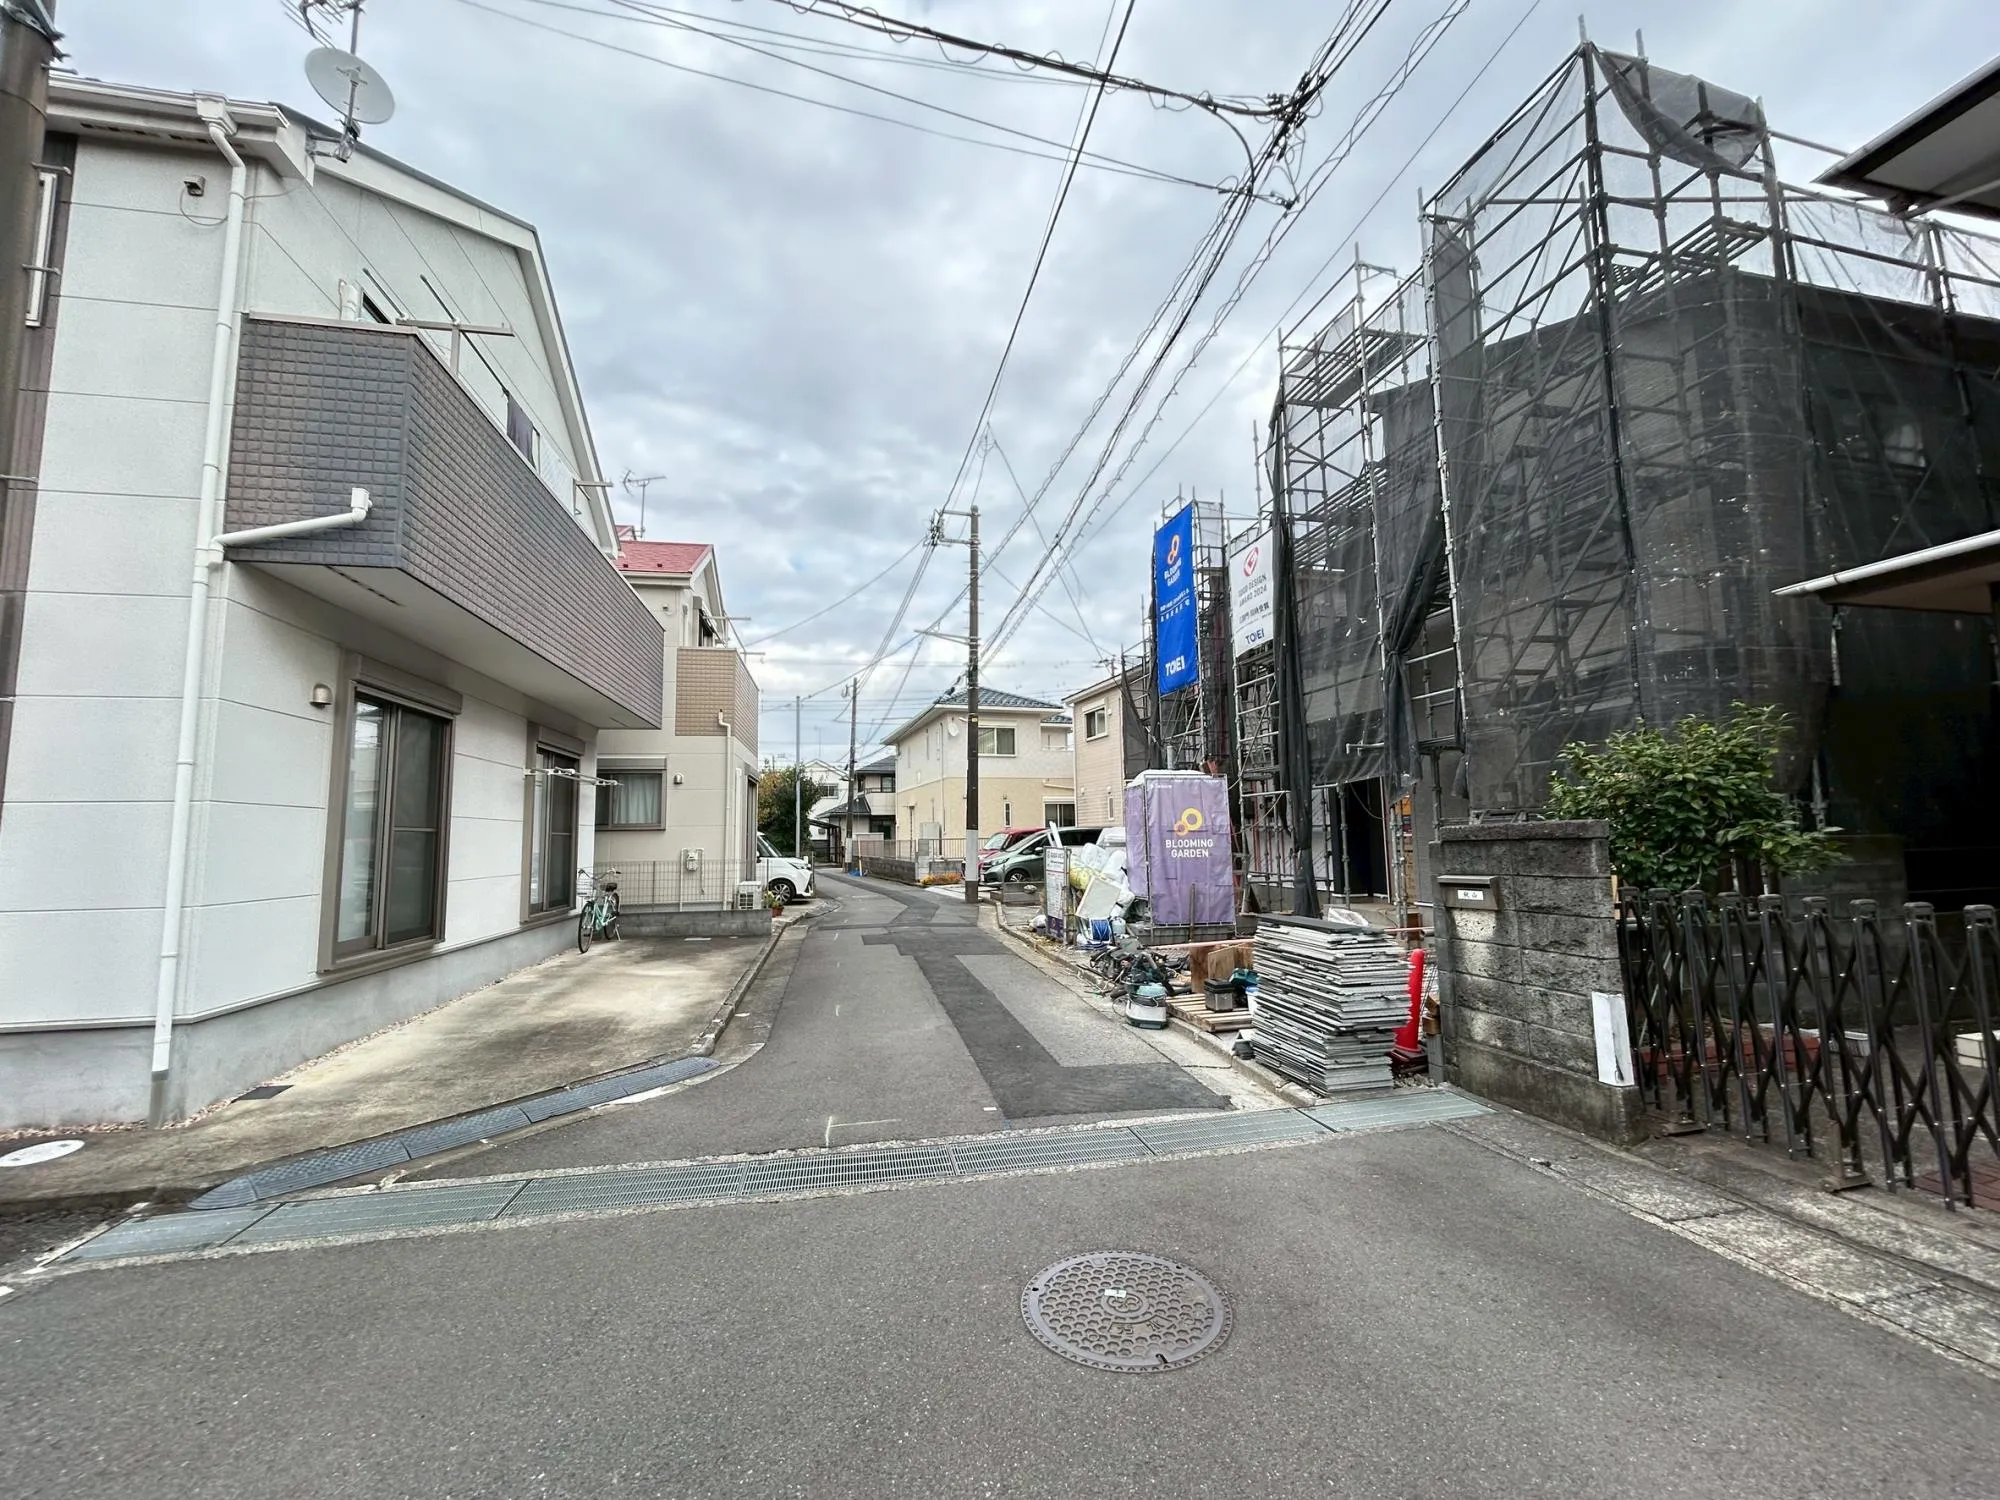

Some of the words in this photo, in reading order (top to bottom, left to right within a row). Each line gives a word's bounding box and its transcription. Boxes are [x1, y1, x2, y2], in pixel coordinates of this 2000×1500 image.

[1248, 574, 1267, 590] DESIGN
[1253, 584, 1267, 598] 2024
[1245, 628, 1265, 645] TOEI
[1165, 655, 1185, 677] TOEI
[1165, 838, 1214, 849] BLOOMING
[1171, 848, 1209, 858] GARDEN
